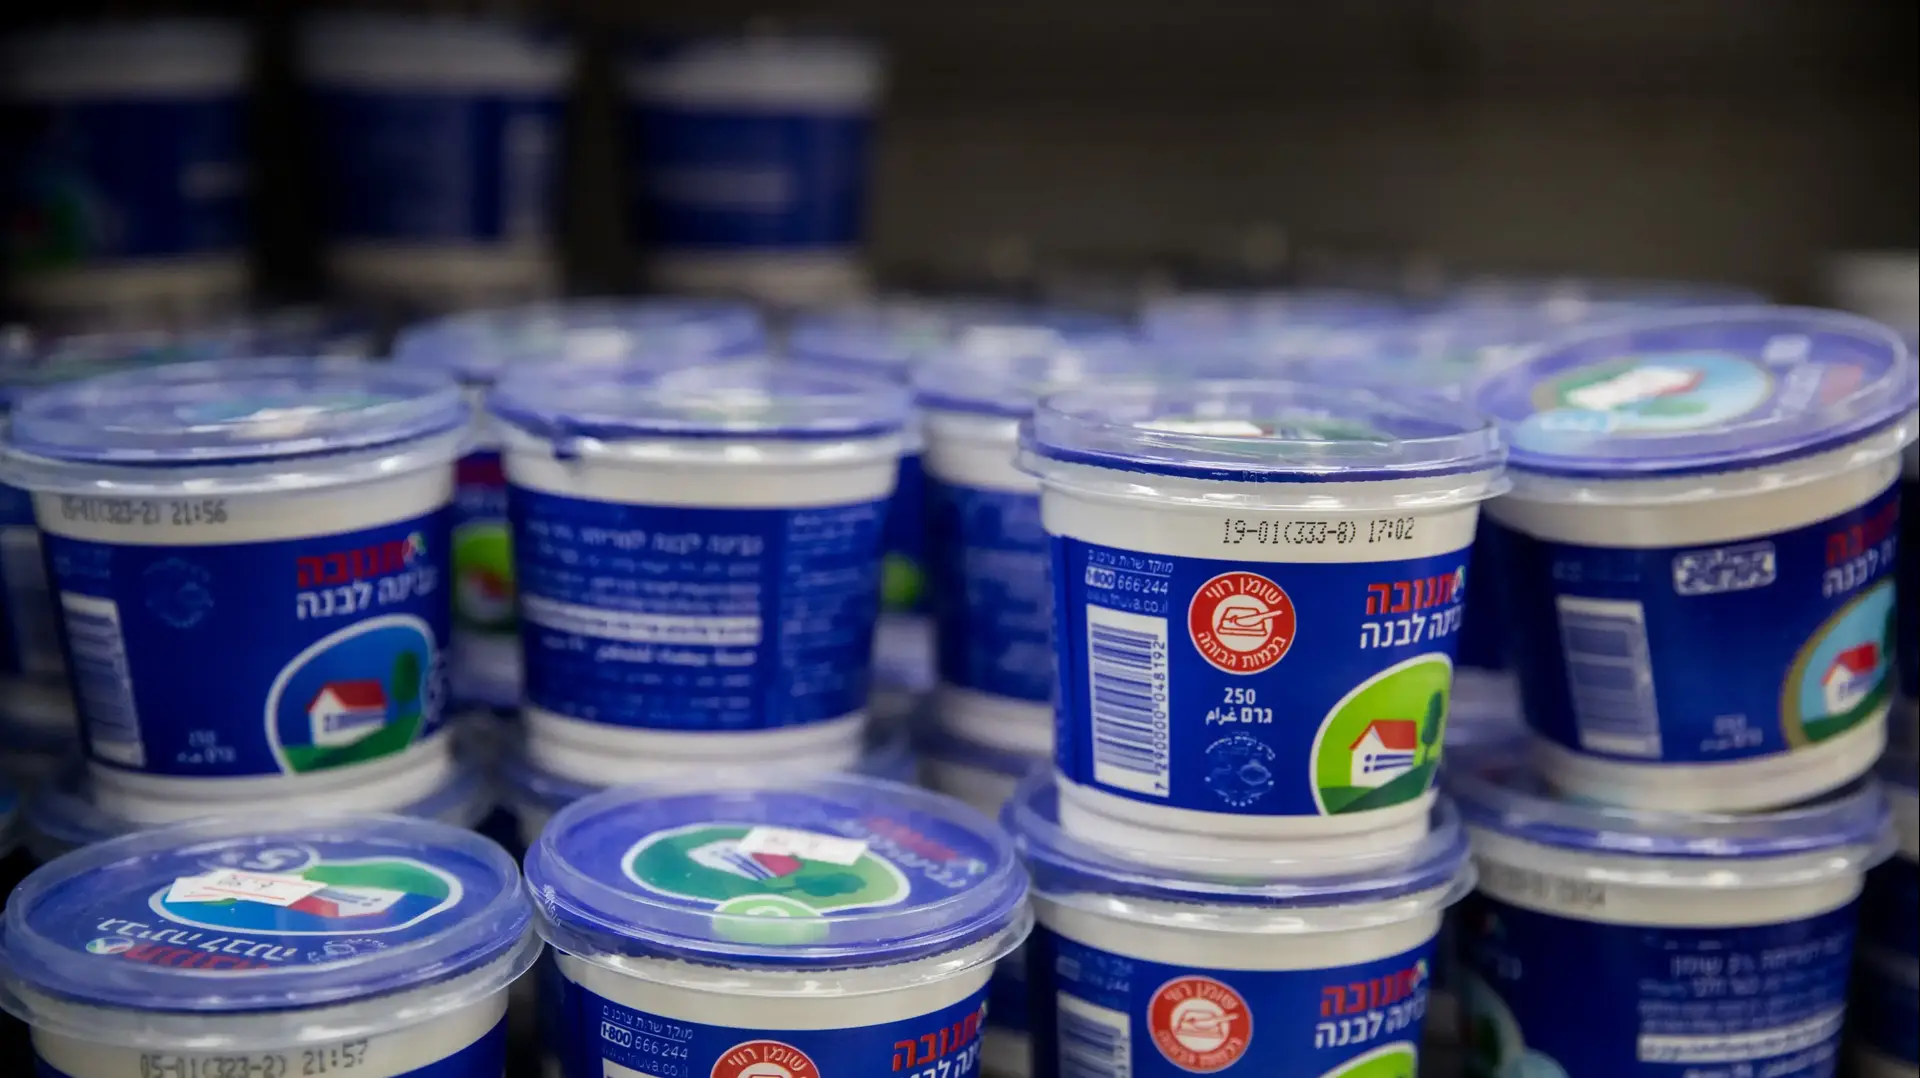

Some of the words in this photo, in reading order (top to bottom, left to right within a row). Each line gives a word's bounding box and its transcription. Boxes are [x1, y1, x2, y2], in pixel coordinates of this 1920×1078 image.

[171, 498, 228, 526] 21:56
[1223, 518, 1356, 544] 19-01(333-8)
[1368, 516, 1415, 543] 17:02
[297, 540, 405, 589] תנובה
[1085, 566, 1116, 590] 1800
[1148, 559, 1174, 574] מוקד
[296, 579, 373, 620] לבנה
[1204, 579, 1234, 599] רווי
[1240, 577, 1283, 605] שומן
[1366, 573, 1455, 615] תנובה
[1361, 612, 1427, 649] לבנה
[1198, 631, 1237, 667] גבוהה
[1242, 636, 1287, 668] בכמות
[1152, 640, 1166, 702] 048192
[1223, 687, 1257, 705] 250
[1240, 706, 1273, 724] גרם
[1320, 967, 1414, 1017] תנובה
[602, 1004, 634, 1025] צרכנם
[602, 1022, 632, 1047] 1-800
[666, 1024, 694, 1040] מוקד
[892, 1011, 977, 1072] תנובה
[1315, 1009, 1384, 1049] לבנה
[302, 1038, 369, 1077] 21:57
[727, 1047, 758, 1066] רווי
[764, 1046, 808, 1071] שומן
